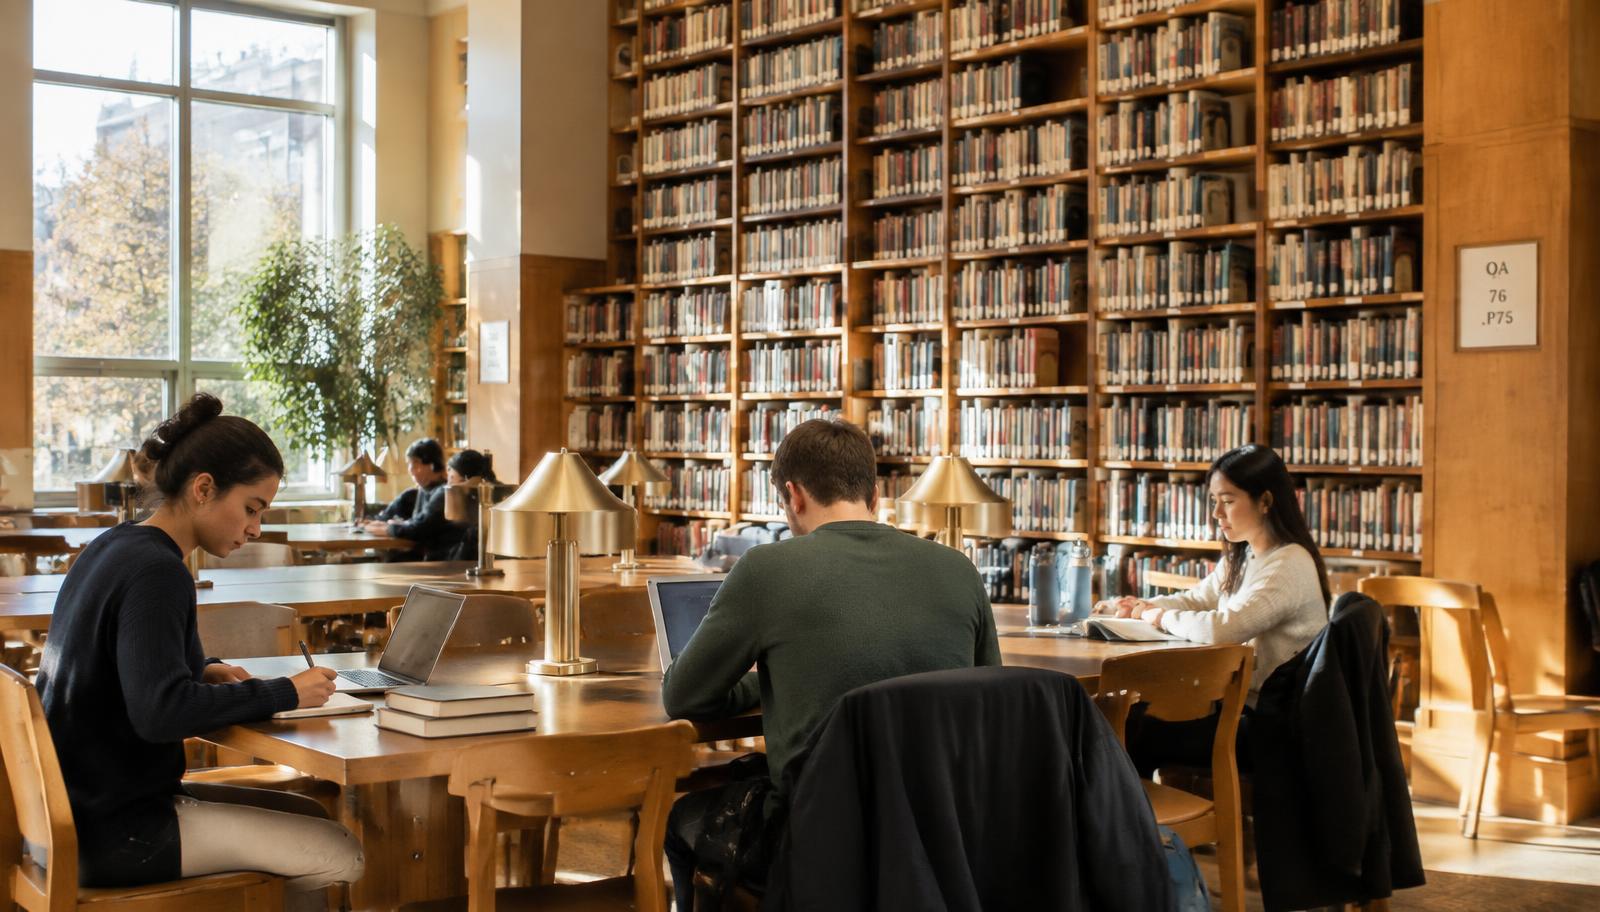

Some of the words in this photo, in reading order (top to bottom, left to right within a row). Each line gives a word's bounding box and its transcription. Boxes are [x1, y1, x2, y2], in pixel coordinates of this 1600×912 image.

[1486, 261, 1509, 278] QA
[1489, 289, 1507, 303] 76
[1482, 311, 1514, 325] .P75
